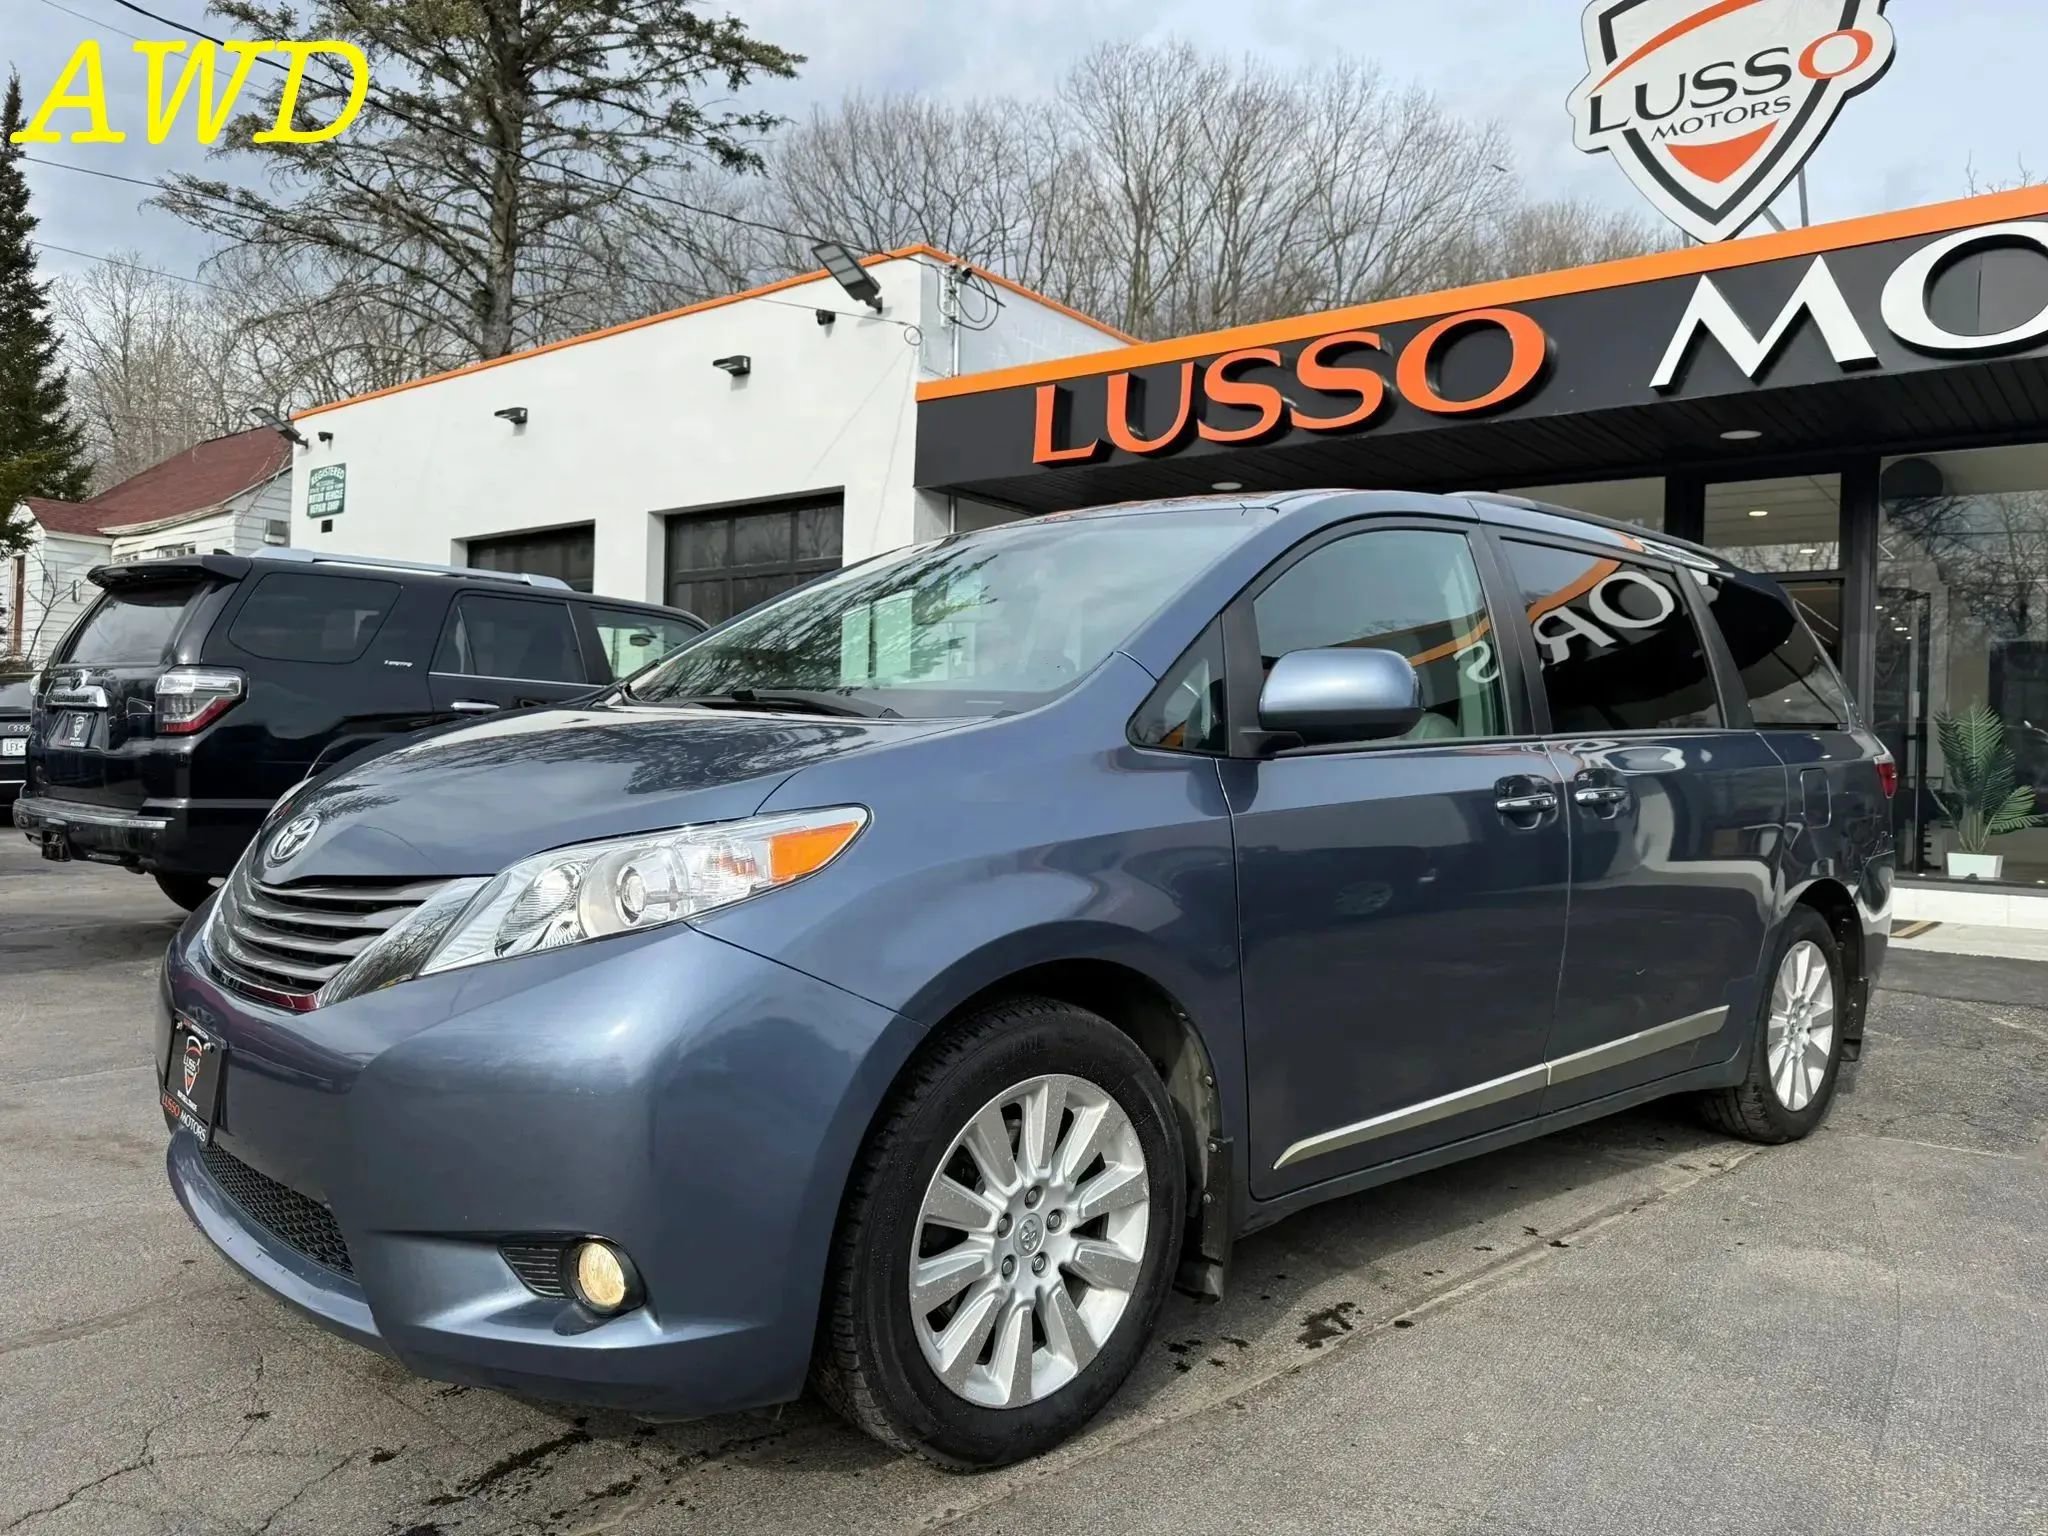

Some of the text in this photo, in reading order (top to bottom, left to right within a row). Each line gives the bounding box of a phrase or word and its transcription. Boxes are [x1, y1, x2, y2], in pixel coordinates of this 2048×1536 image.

[1589, 29, 1874, 135] LUSSO
[1651, 96, 1791, 141] MOTORS
[1032, 308, 1547, 464] LUSSO
[311, 466, 345, 486] REGISTERED
[162, 1093, 180, 1117] LUSSO
[180, 1110, 207, 1142] MOTORS
